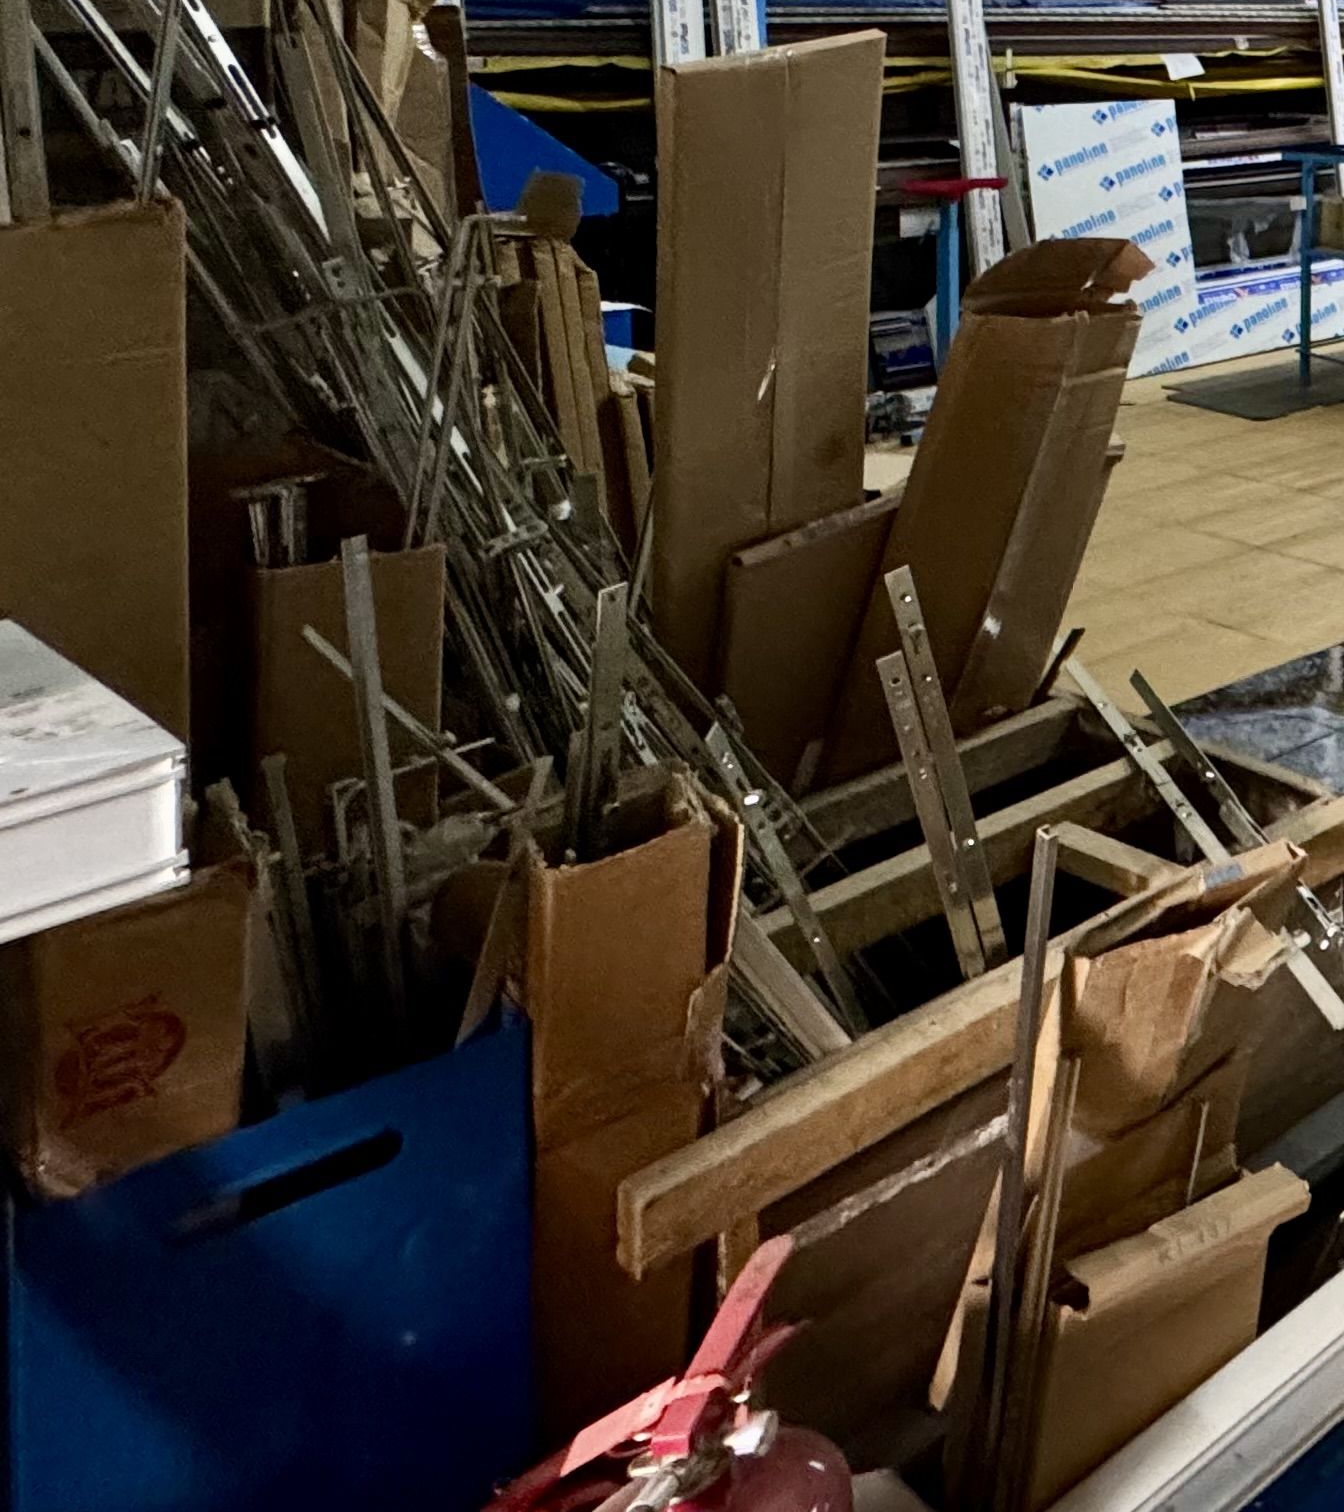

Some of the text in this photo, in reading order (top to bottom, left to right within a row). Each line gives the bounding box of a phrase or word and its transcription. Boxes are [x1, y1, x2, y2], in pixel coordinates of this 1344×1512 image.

[1054, 142, 1108, 176] panoline
[1115, 154, 1166, 187] panoline
[1130, 219, 1174, 245] anoline
[1243, 297, 1289, 333] panoline
